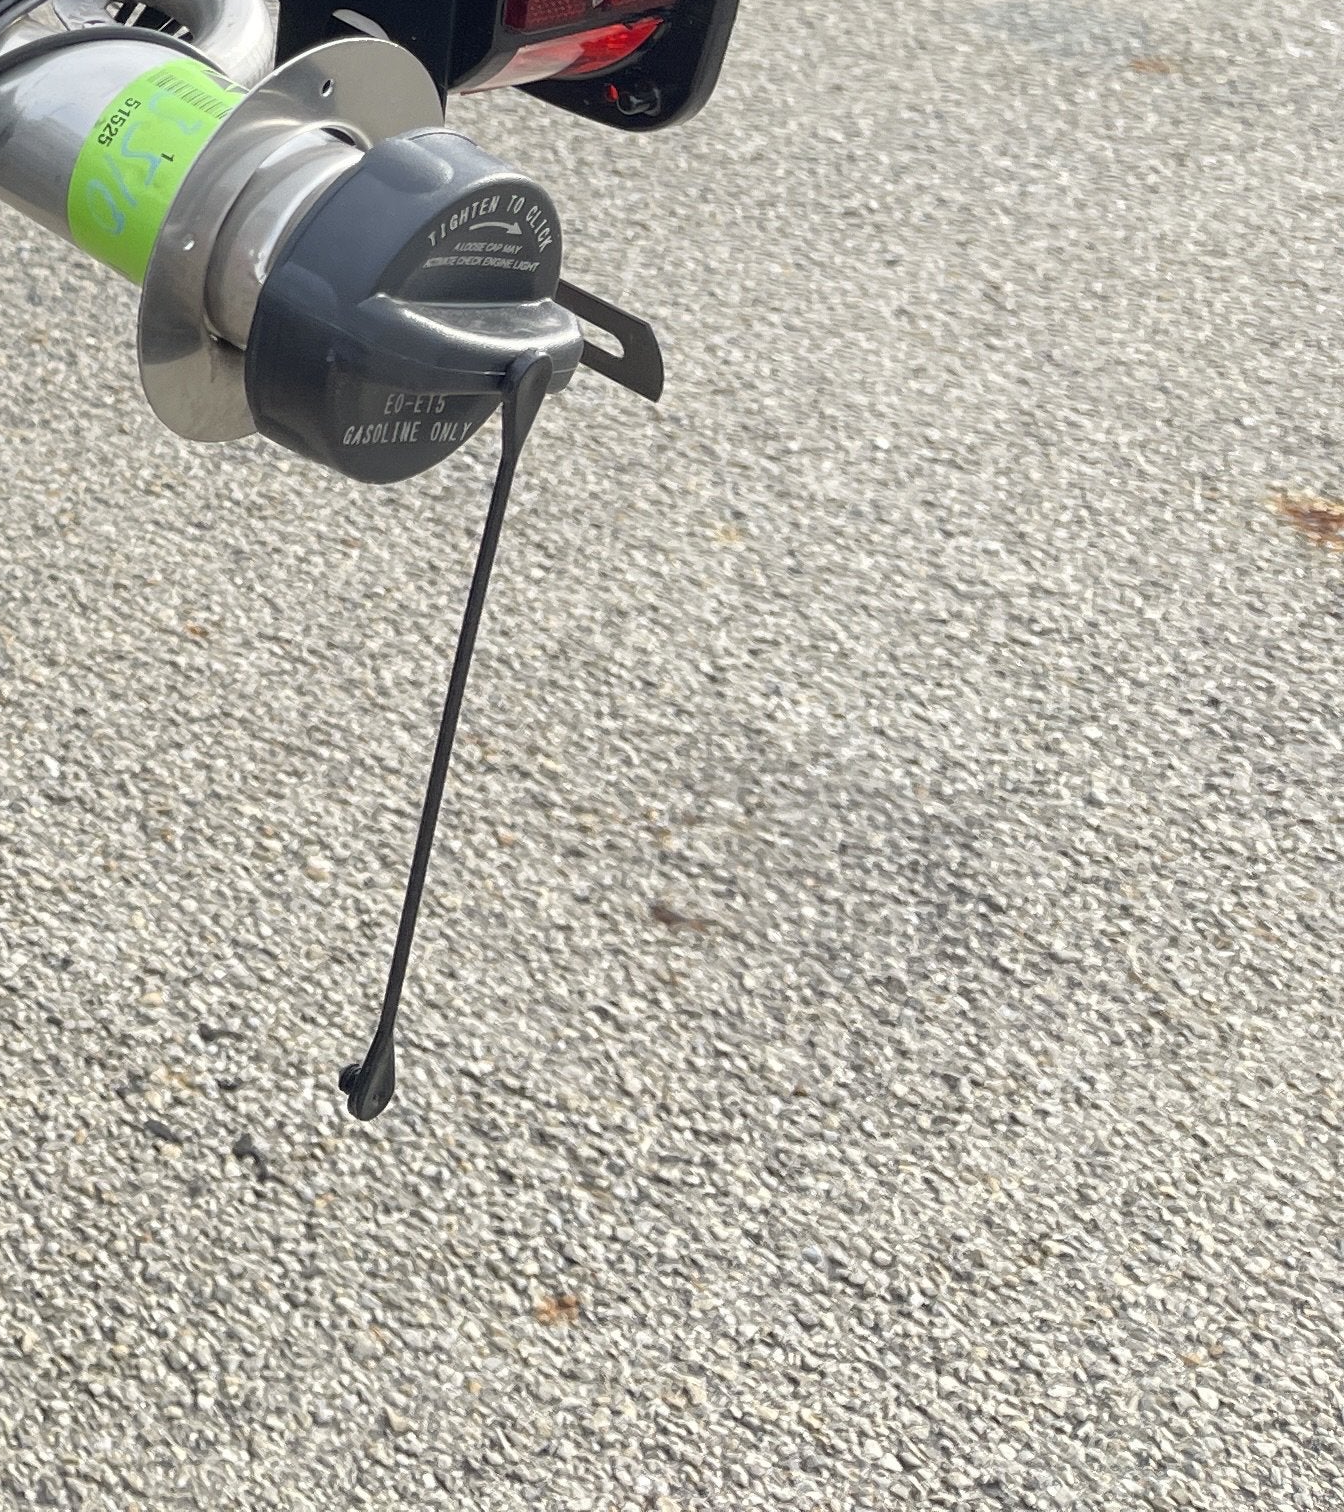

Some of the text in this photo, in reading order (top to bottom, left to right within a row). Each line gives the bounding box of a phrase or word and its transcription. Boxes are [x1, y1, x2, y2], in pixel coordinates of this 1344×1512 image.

[97, 97, 142, 147] 51525
[428, 194, 553, 253] TIGHTEN TO CLICK
[486, 243, 503, 252] CAP
[503, 244, 523, 255] MAY
[482, 257, 515, 269] ENGINE
[513, 260, 540, 273] LIGHT
[343, 421, 473, 446] GASOLINE ONLY
